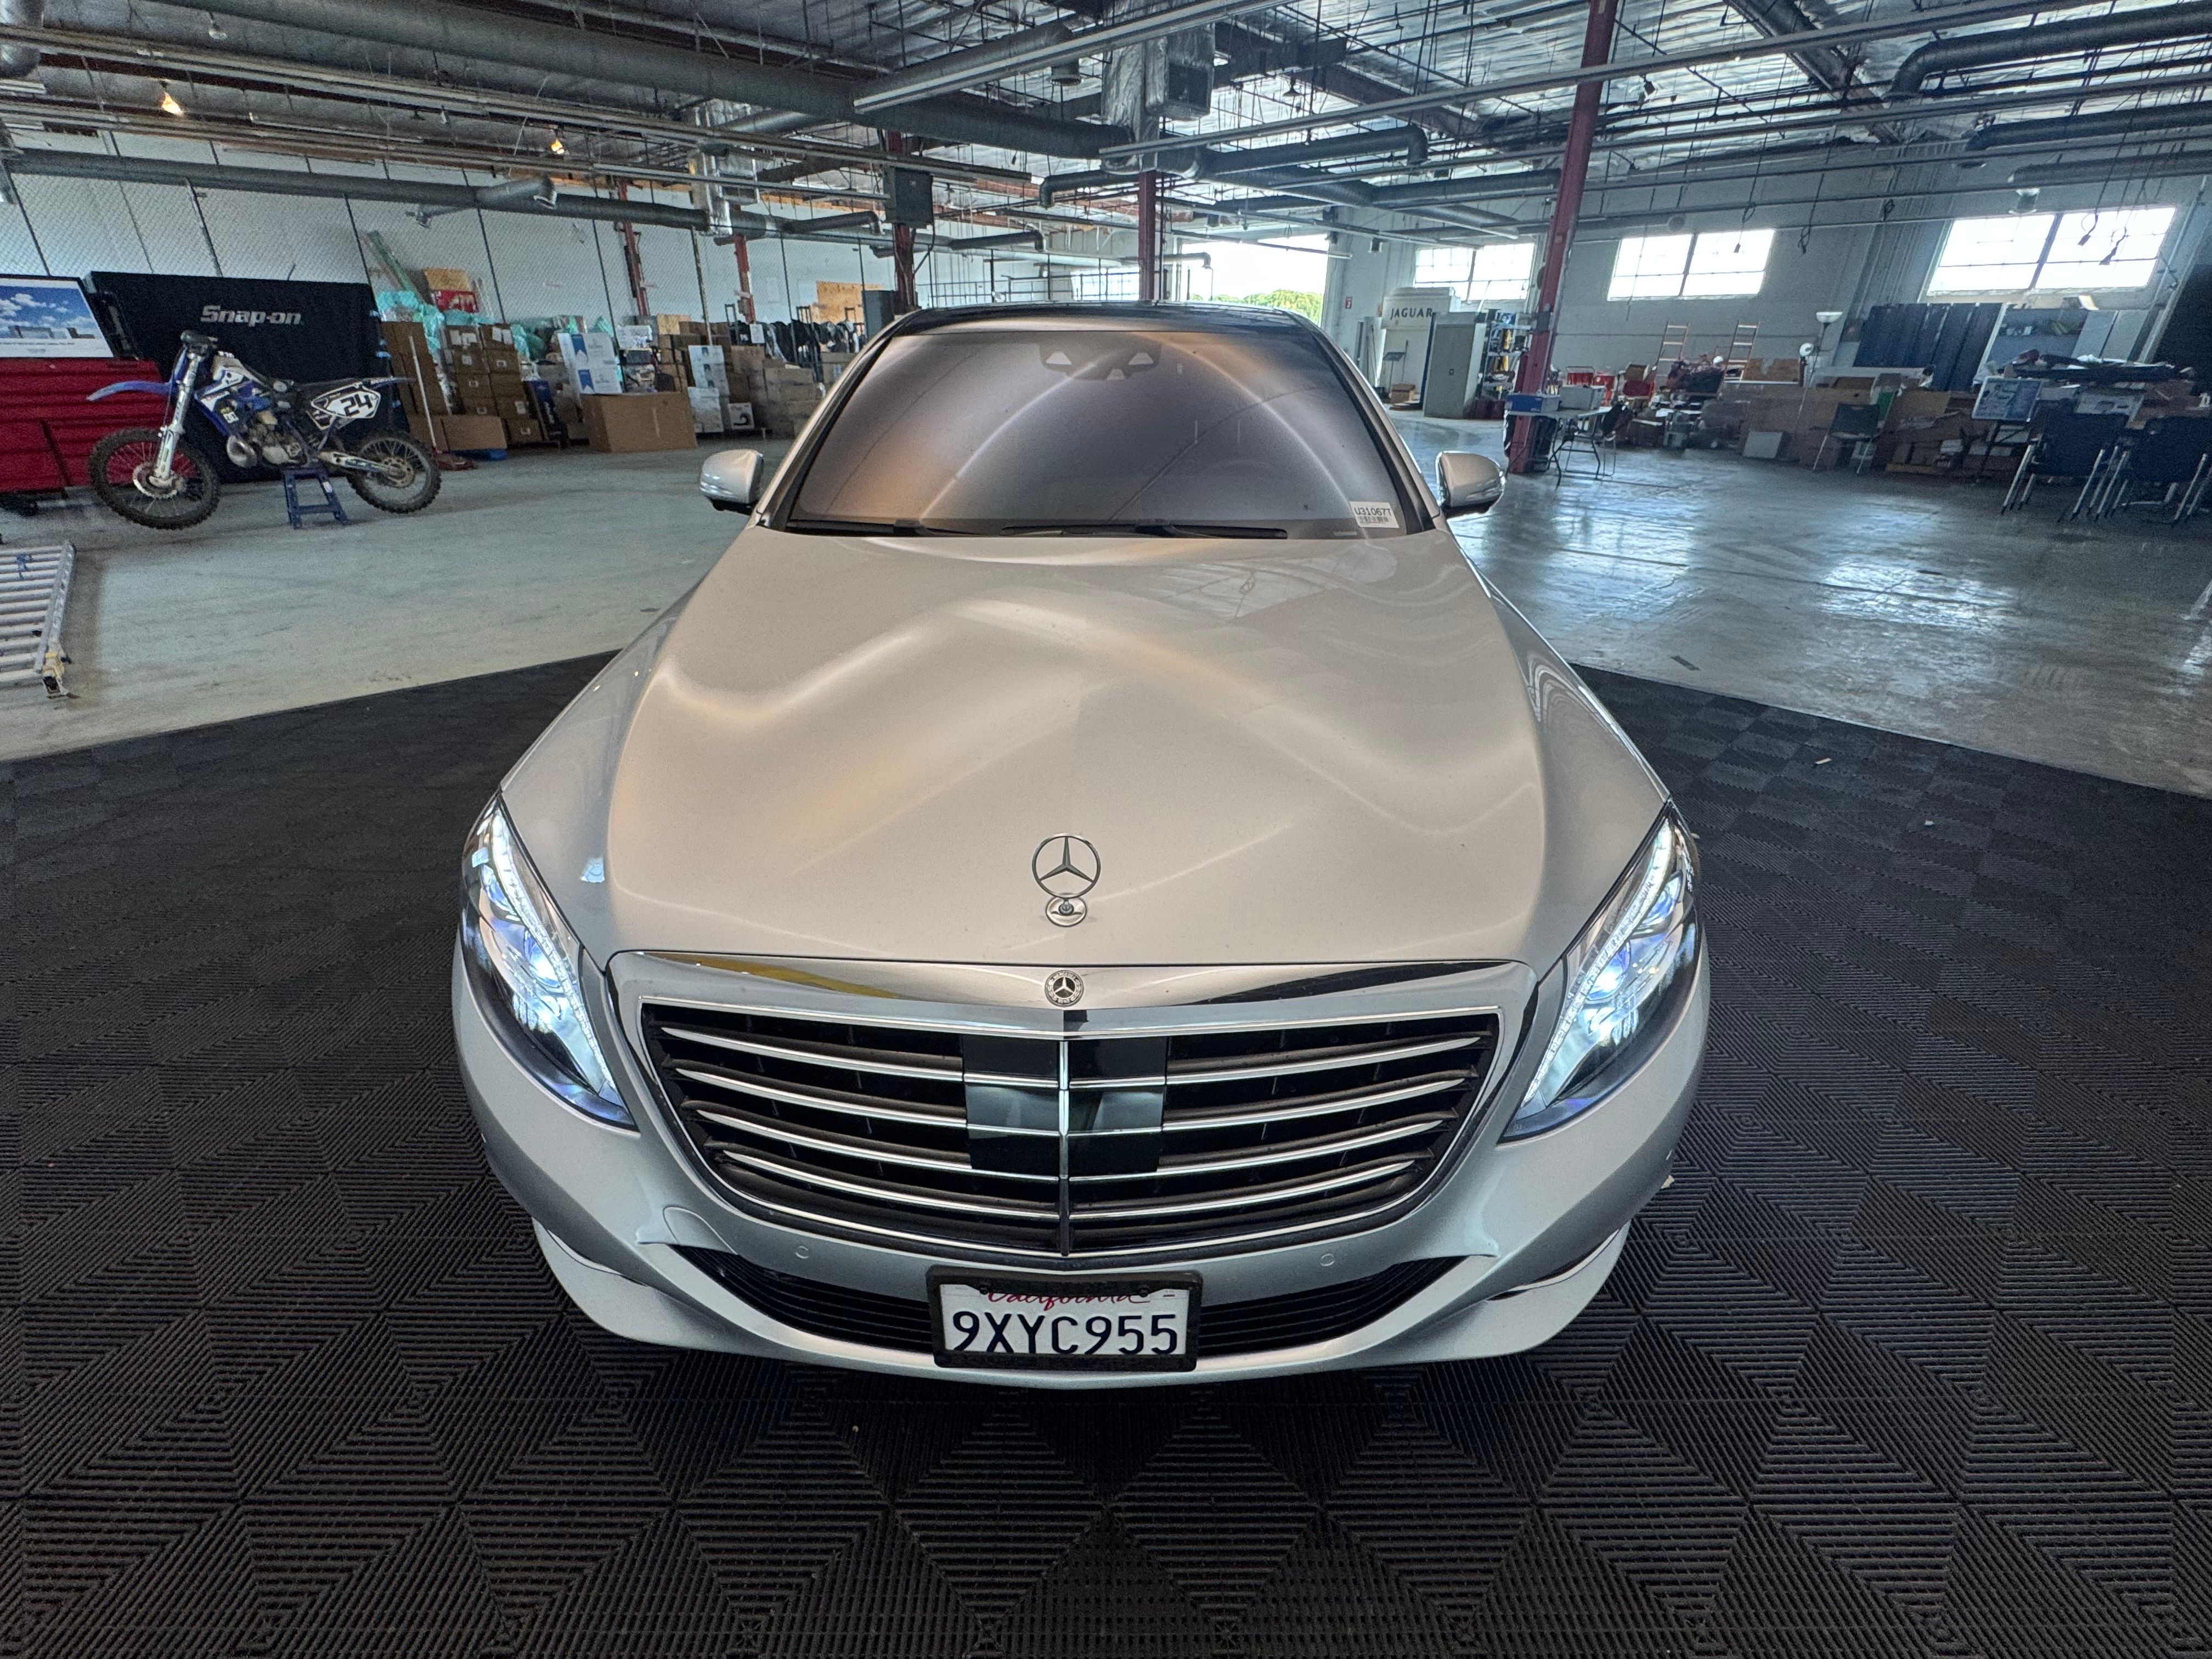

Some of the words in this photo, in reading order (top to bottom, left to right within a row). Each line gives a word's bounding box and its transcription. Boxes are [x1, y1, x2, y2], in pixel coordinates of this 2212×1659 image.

[201, 305, 301, 327] Snap-on
[1390, 308, 1433, 320] JAGUAR
[340, 394, 373, 417] 24
[1354, 507, 1392, 516] U31067T
[953, 1311, 1177, 1355] 9XYC955
